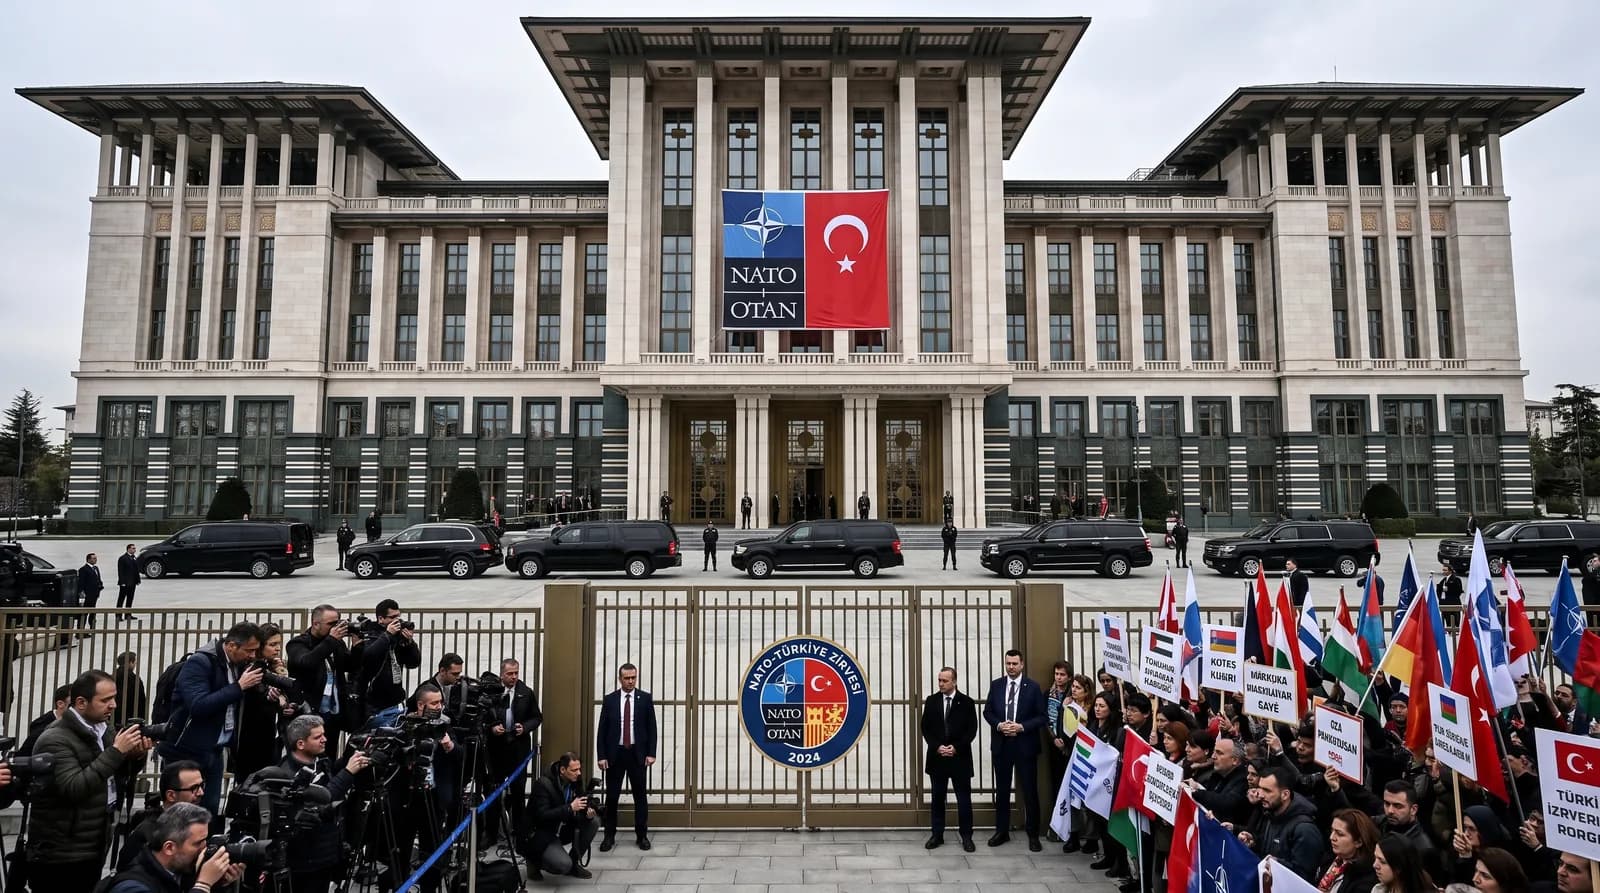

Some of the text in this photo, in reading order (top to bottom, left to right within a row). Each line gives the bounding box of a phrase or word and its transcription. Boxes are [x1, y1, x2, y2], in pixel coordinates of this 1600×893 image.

[730, 266, 797, 284] NATO
[730, 301, 798, 319] OTAN
[749, 641, 865, 695] NATO-TÜRKİYE ZİRVESİ
[767, 708, 801, 719] NATO
[767, 729, 801, 739] OTAN
[788, 752, 821, 764] 2024
